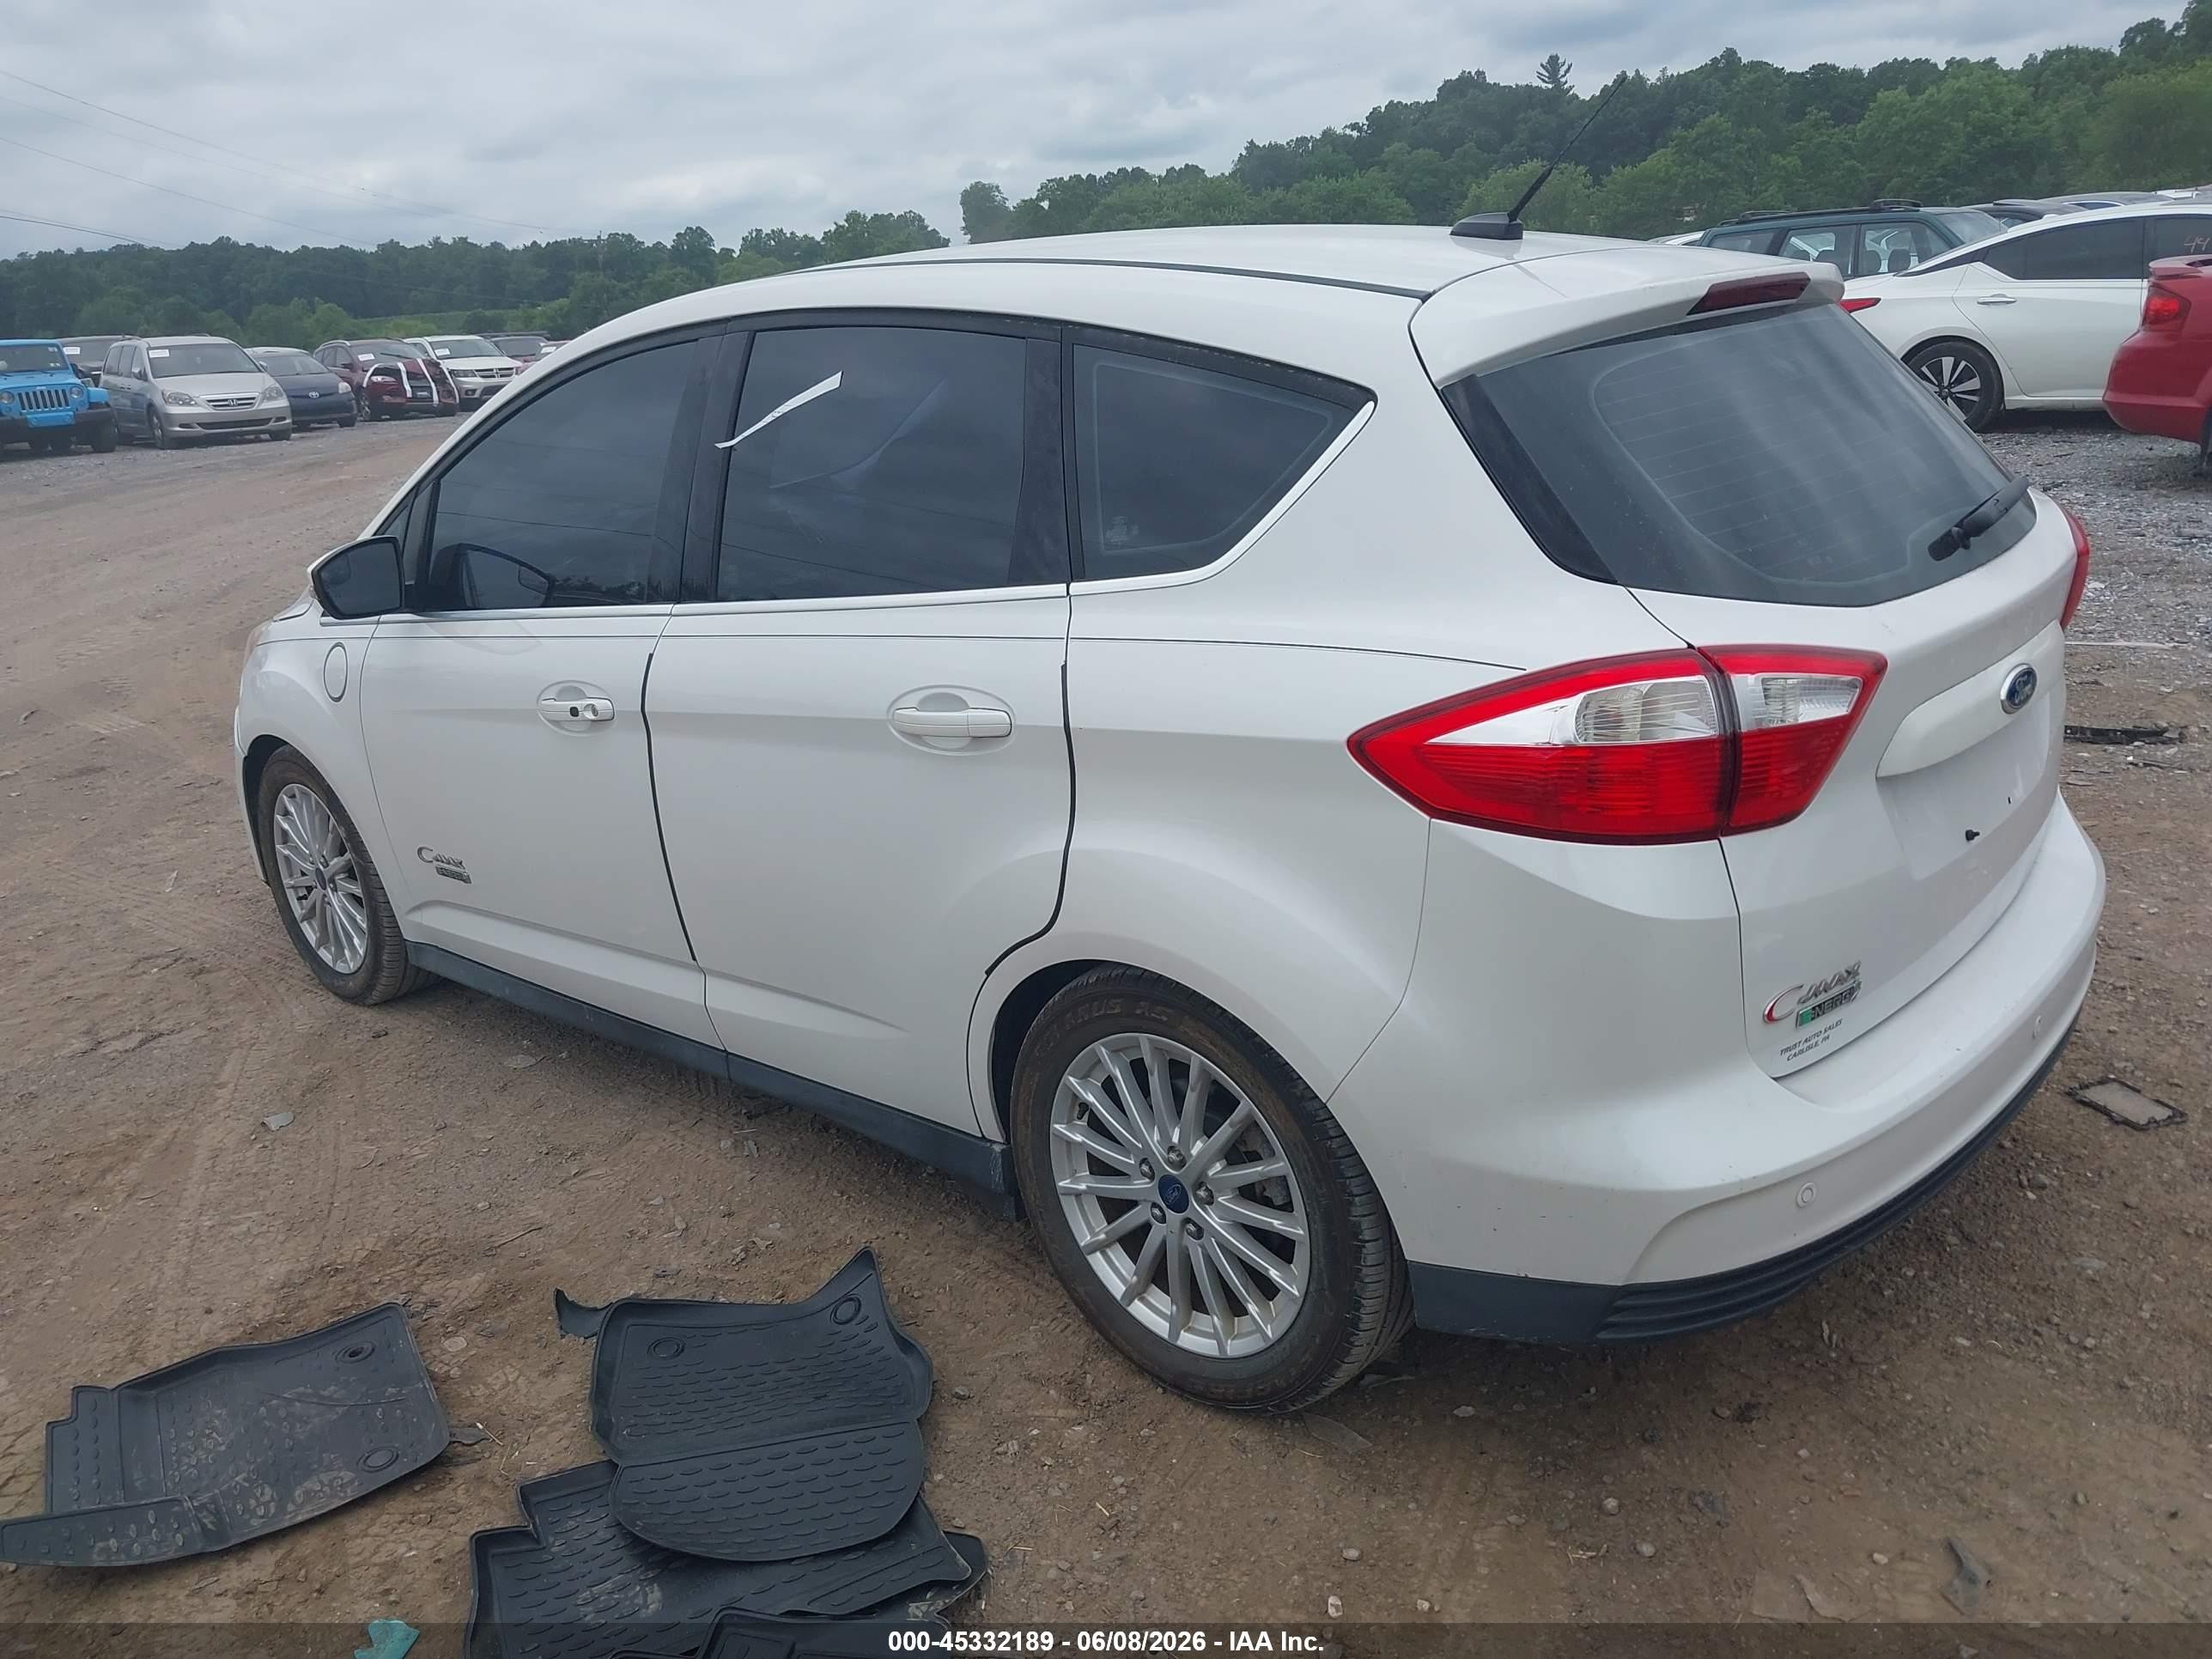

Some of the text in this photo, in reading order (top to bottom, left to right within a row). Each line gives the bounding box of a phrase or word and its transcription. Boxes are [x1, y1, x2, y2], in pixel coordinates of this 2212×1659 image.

[1779, 1018, 1844, 1056] TRUST AUTO SALES
